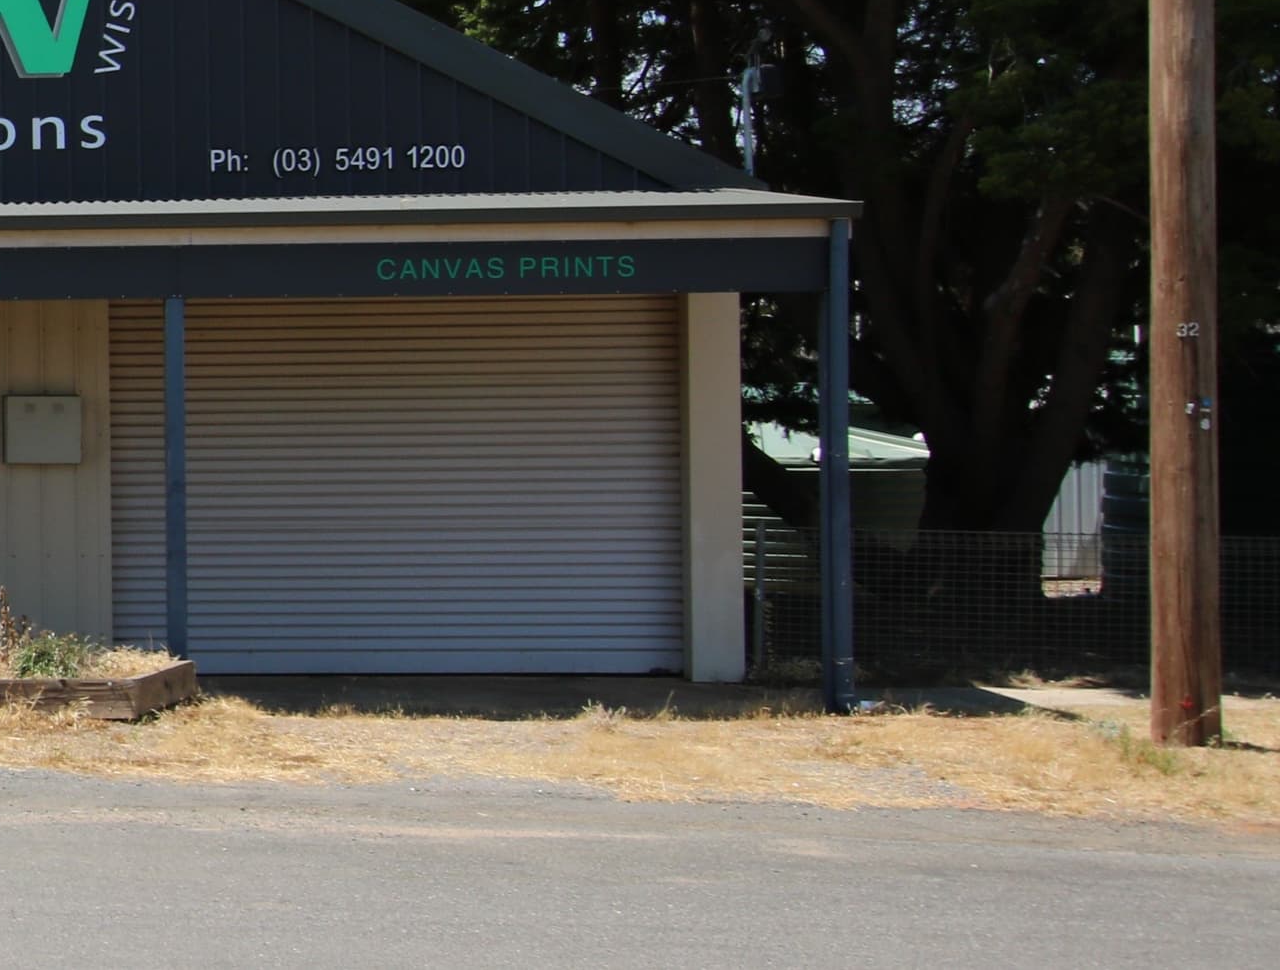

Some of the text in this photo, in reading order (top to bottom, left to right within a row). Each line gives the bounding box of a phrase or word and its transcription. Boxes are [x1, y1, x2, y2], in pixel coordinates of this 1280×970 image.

[210, 145, 465, 178] Ph: (03) 5491 1200
[376, 255, 635, 280] CANVAS PRINTS
[1176, 322, 1200, 337] 32
